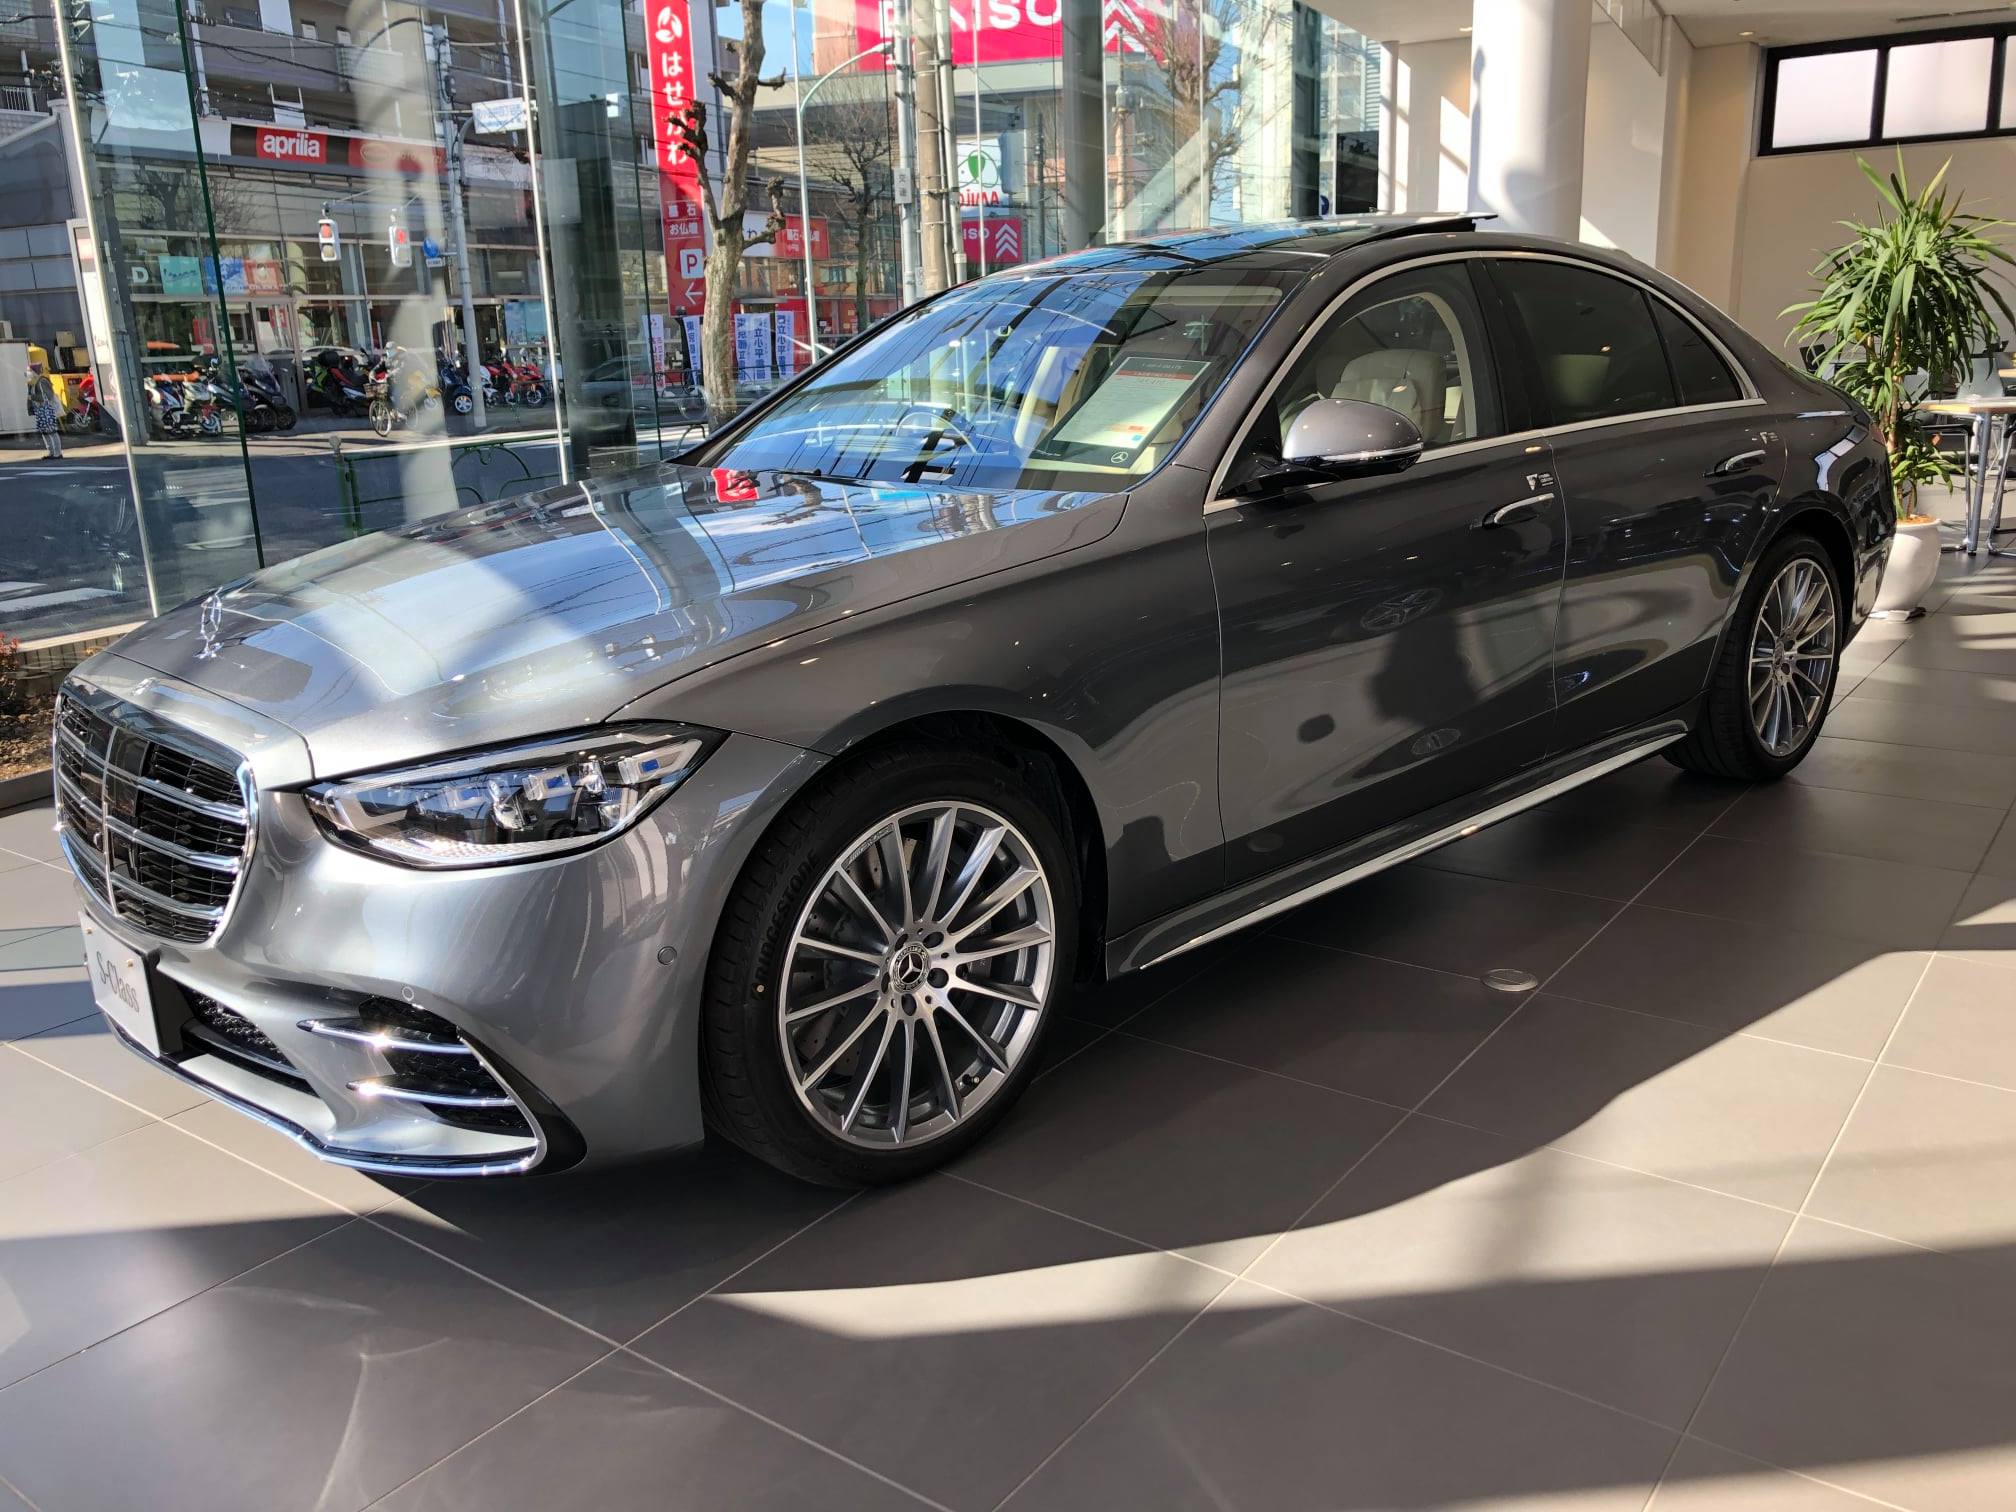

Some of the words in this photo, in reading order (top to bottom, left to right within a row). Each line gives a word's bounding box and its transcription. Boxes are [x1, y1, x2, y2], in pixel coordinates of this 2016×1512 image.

[263, 132, 320, 158] aprilia
[963, 227, 990, 240] ISO
[686, 254, 698, 274] P
[97, 951, 139, 1013] S-Class
